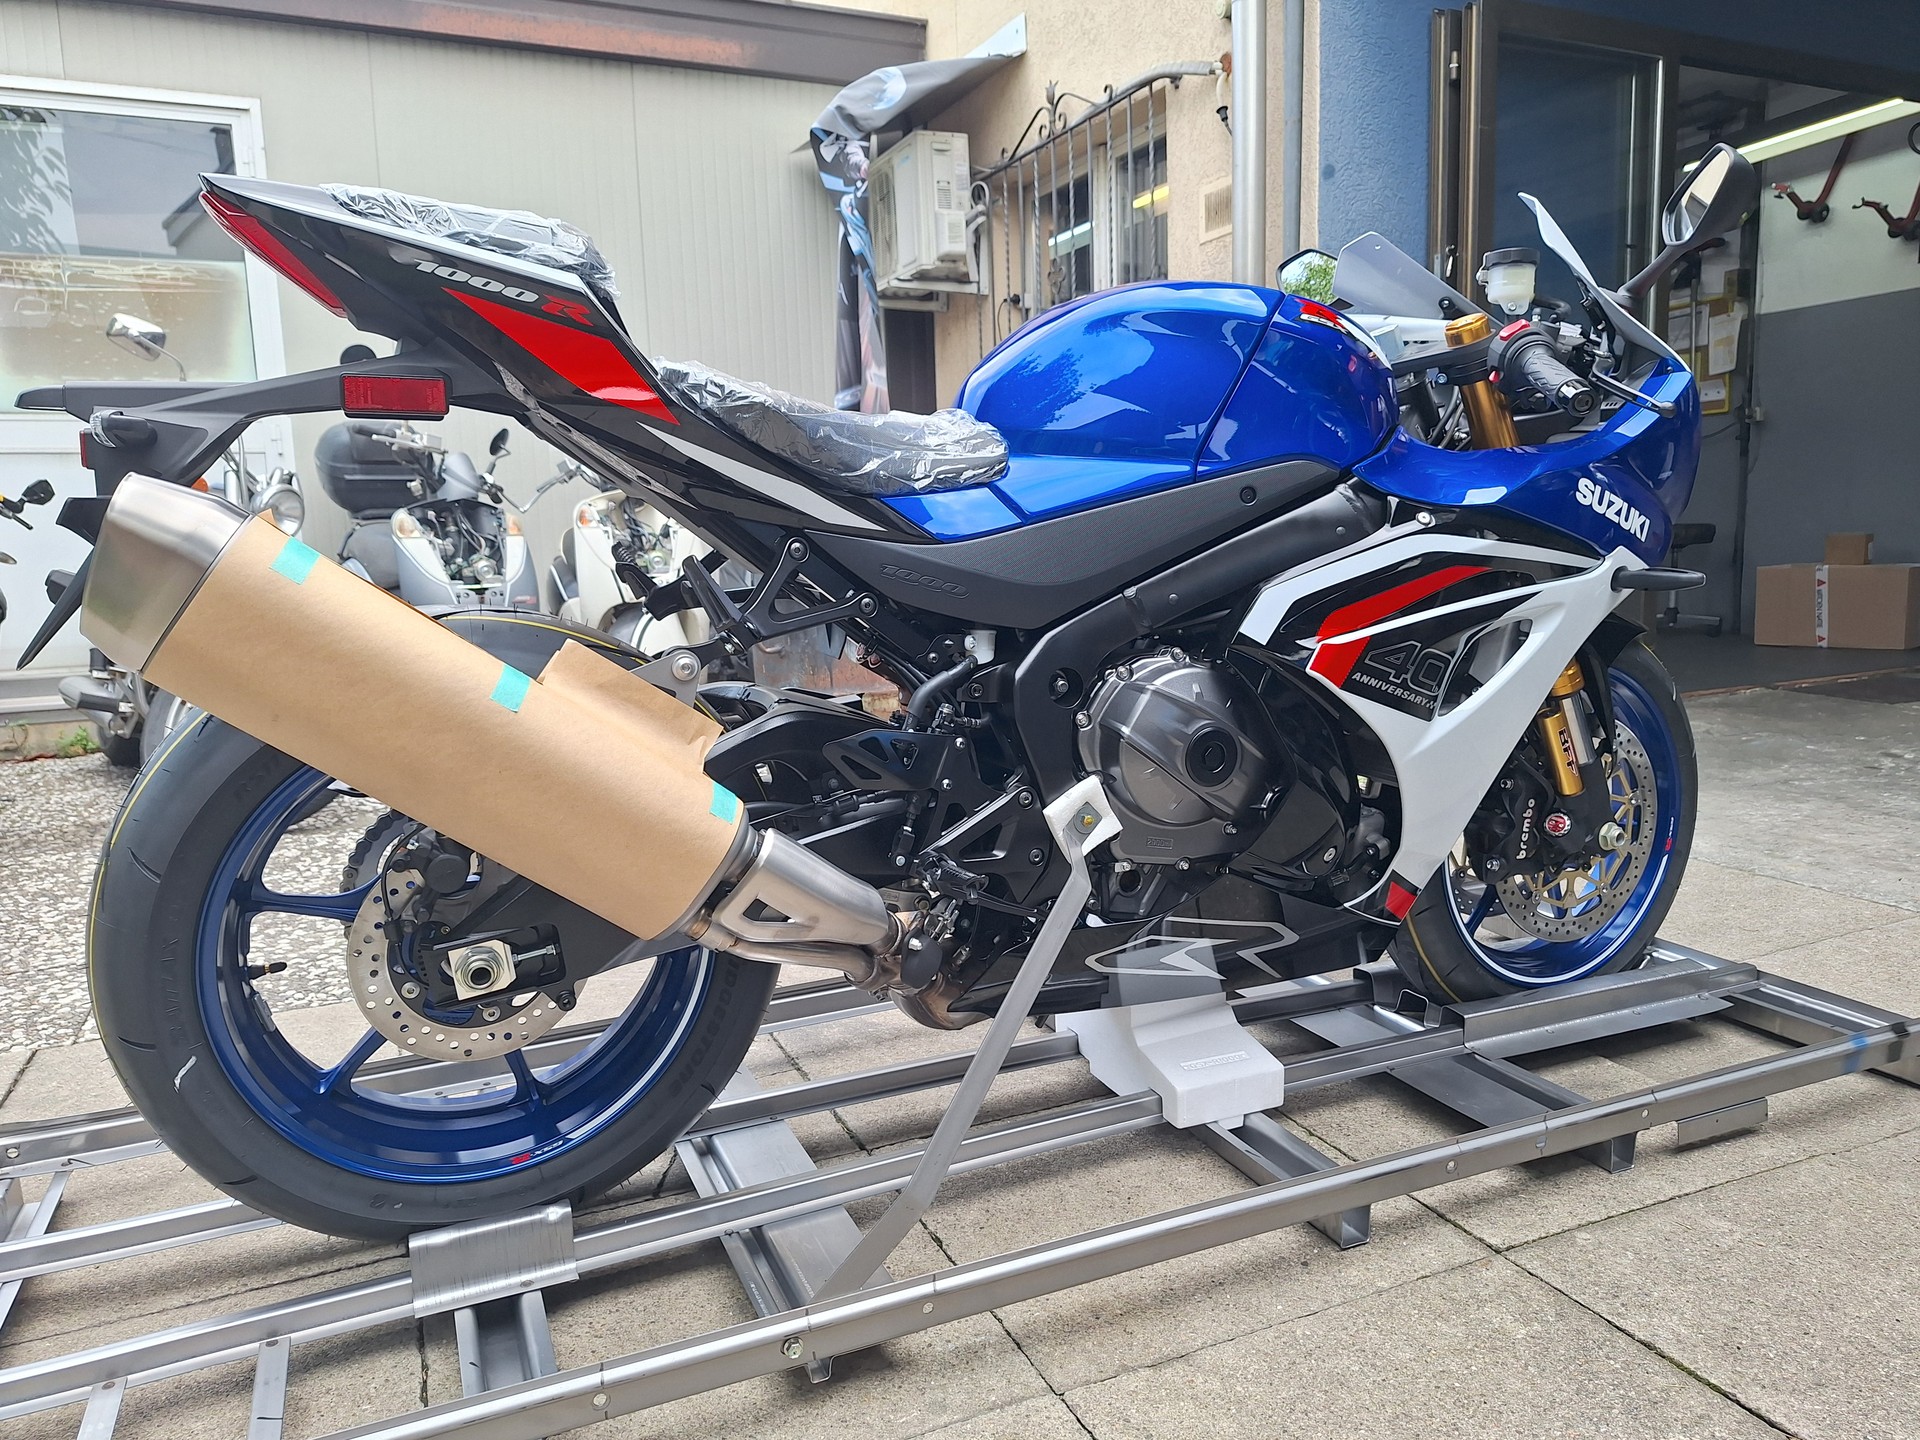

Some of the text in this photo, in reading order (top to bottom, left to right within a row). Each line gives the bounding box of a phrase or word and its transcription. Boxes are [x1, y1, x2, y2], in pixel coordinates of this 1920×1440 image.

[1576, 478, 1651, 543] SUZUKI
[881, 563, 970, 599] 1000
[1352, 672, 1428, 706] ANNIVERSARY
[1516, 798, 1536, 860] brembo
